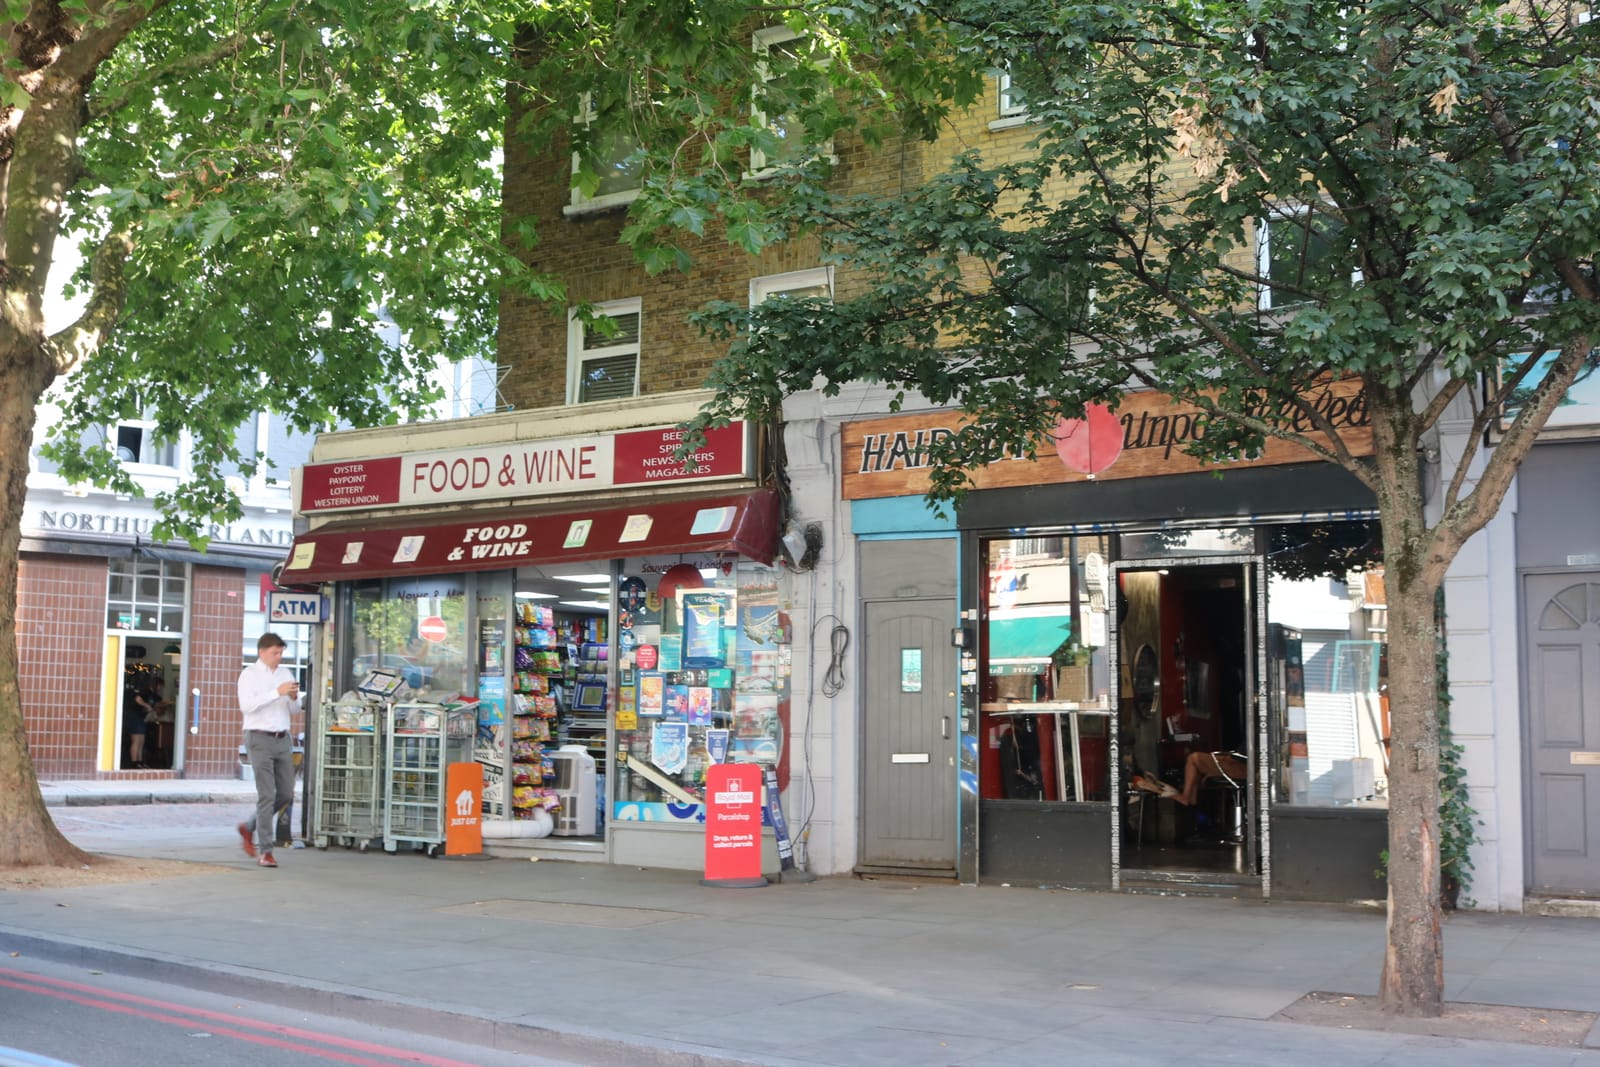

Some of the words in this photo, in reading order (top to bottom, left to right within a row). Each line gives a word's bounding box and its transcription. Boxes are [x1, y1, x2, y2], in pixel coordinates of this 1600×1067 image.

[642, 452, 715, 467] NEWSAPERS
[333, 464, 364, 475] OYSTER
[413, 457, 491, 494] FOOD
[497, 453, 516, 487] &
[523, 445, 597, 485] WINE
[328, 474, 368, 486] PAYPOINT
[330, 485, 365, 496] LOTTERY
[314, 497, 351, 508] WESTERN
[351, 495, 380, 504] UNION
[39, 510, 293, 547] NORTHURLAND
[462, 523, 528, 543] FOOD
[447, 546, 465, 561] &
[471, 540, 533, 560] WINE
[278, 599, 317, 616] ATM
[450, 817, 465, 827] JUST
[465, 817, 478, 825] EAT
